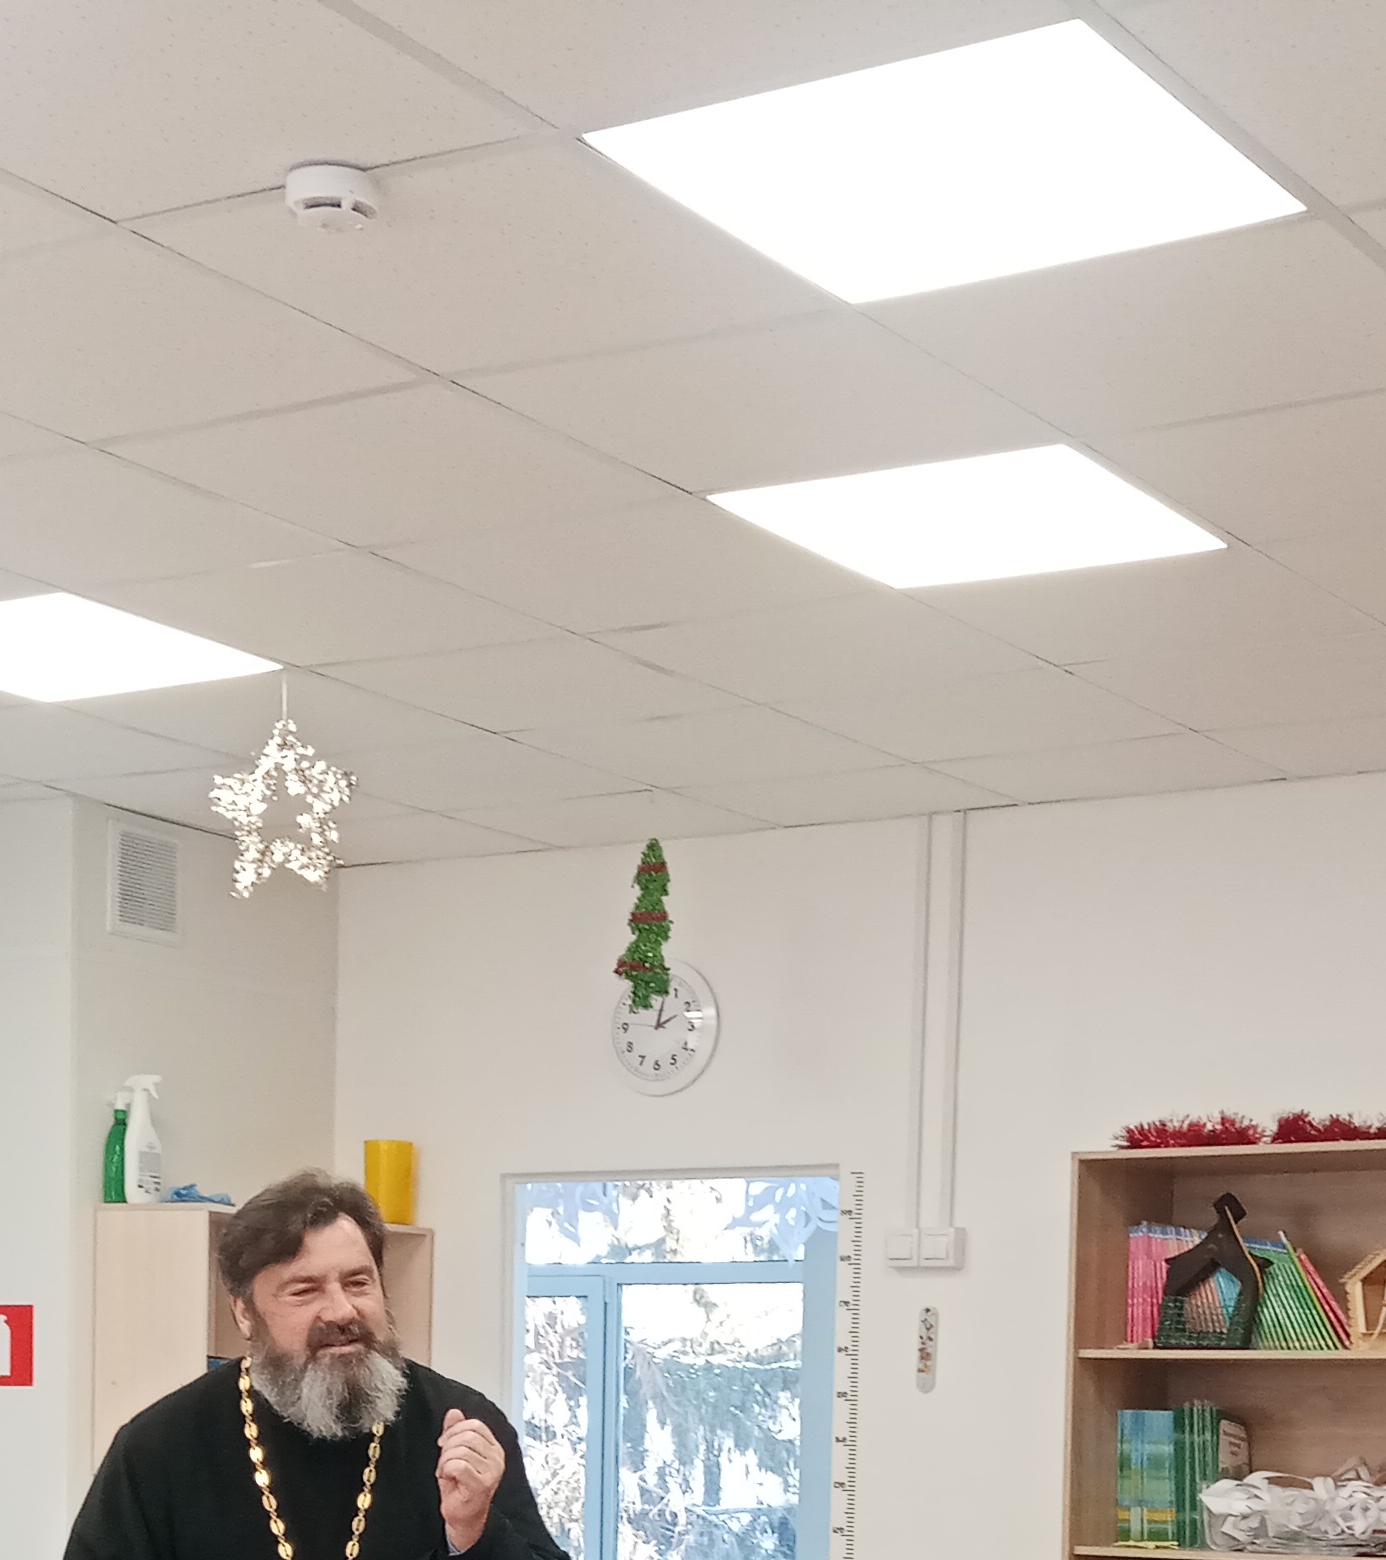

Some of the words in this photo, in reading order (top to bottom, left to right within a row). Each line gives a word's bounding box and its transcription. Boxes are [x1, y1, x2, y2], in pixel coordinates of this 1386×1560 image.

[674, 988, 678, 998] 1
[684, 1001, 691, 1011] 2
[622, 1023, 629, 1033] 9
[687, 1022, 695, 1031] 3
[626, 1042, 633, 1053] 8
[638, 1055, 646, 1066] 7
[670, 1054, 677, 1065] 5
[653, 1060, 661, 1070] 6
